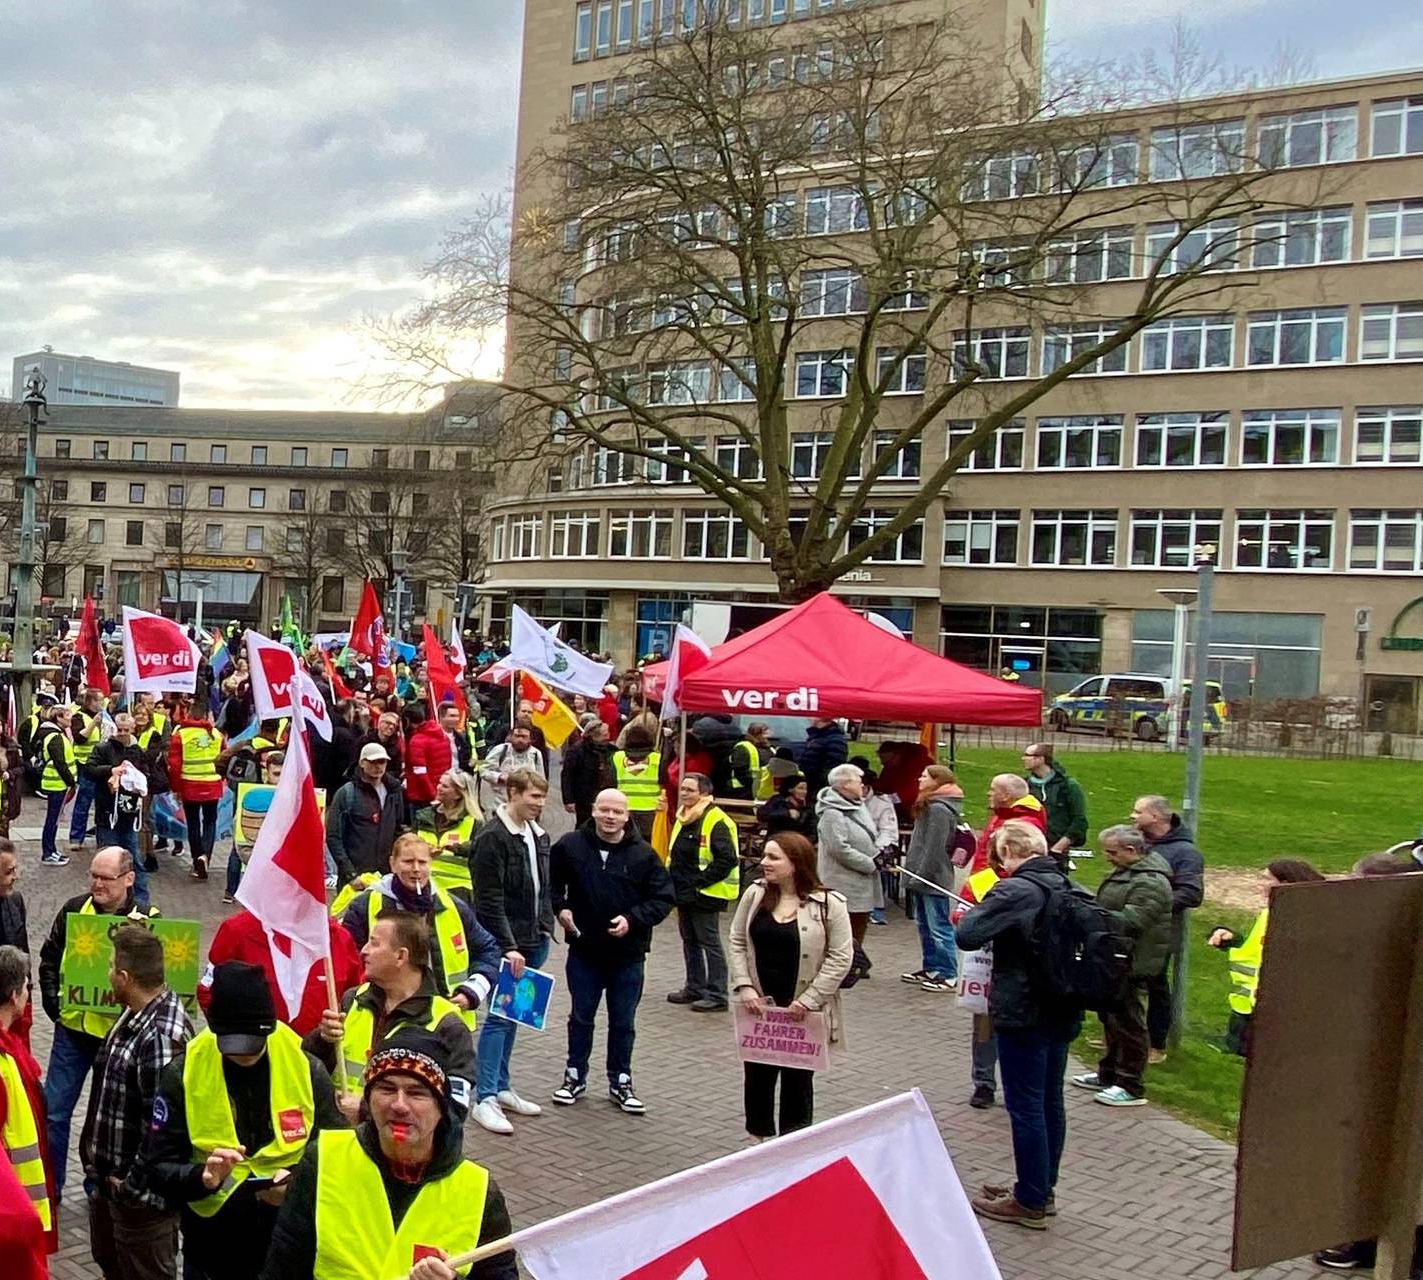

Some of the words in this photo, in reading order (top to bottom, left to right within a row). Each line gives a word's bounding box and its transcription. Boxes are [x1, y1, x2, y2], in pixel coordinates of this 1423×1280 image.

[139, 652, 168, 666] ver
[172, 650, 190, 666] di
[754, 1022, 806, 1040] FAHREN
[741, 1034, 822, 1057] ZUSAMMEN!
